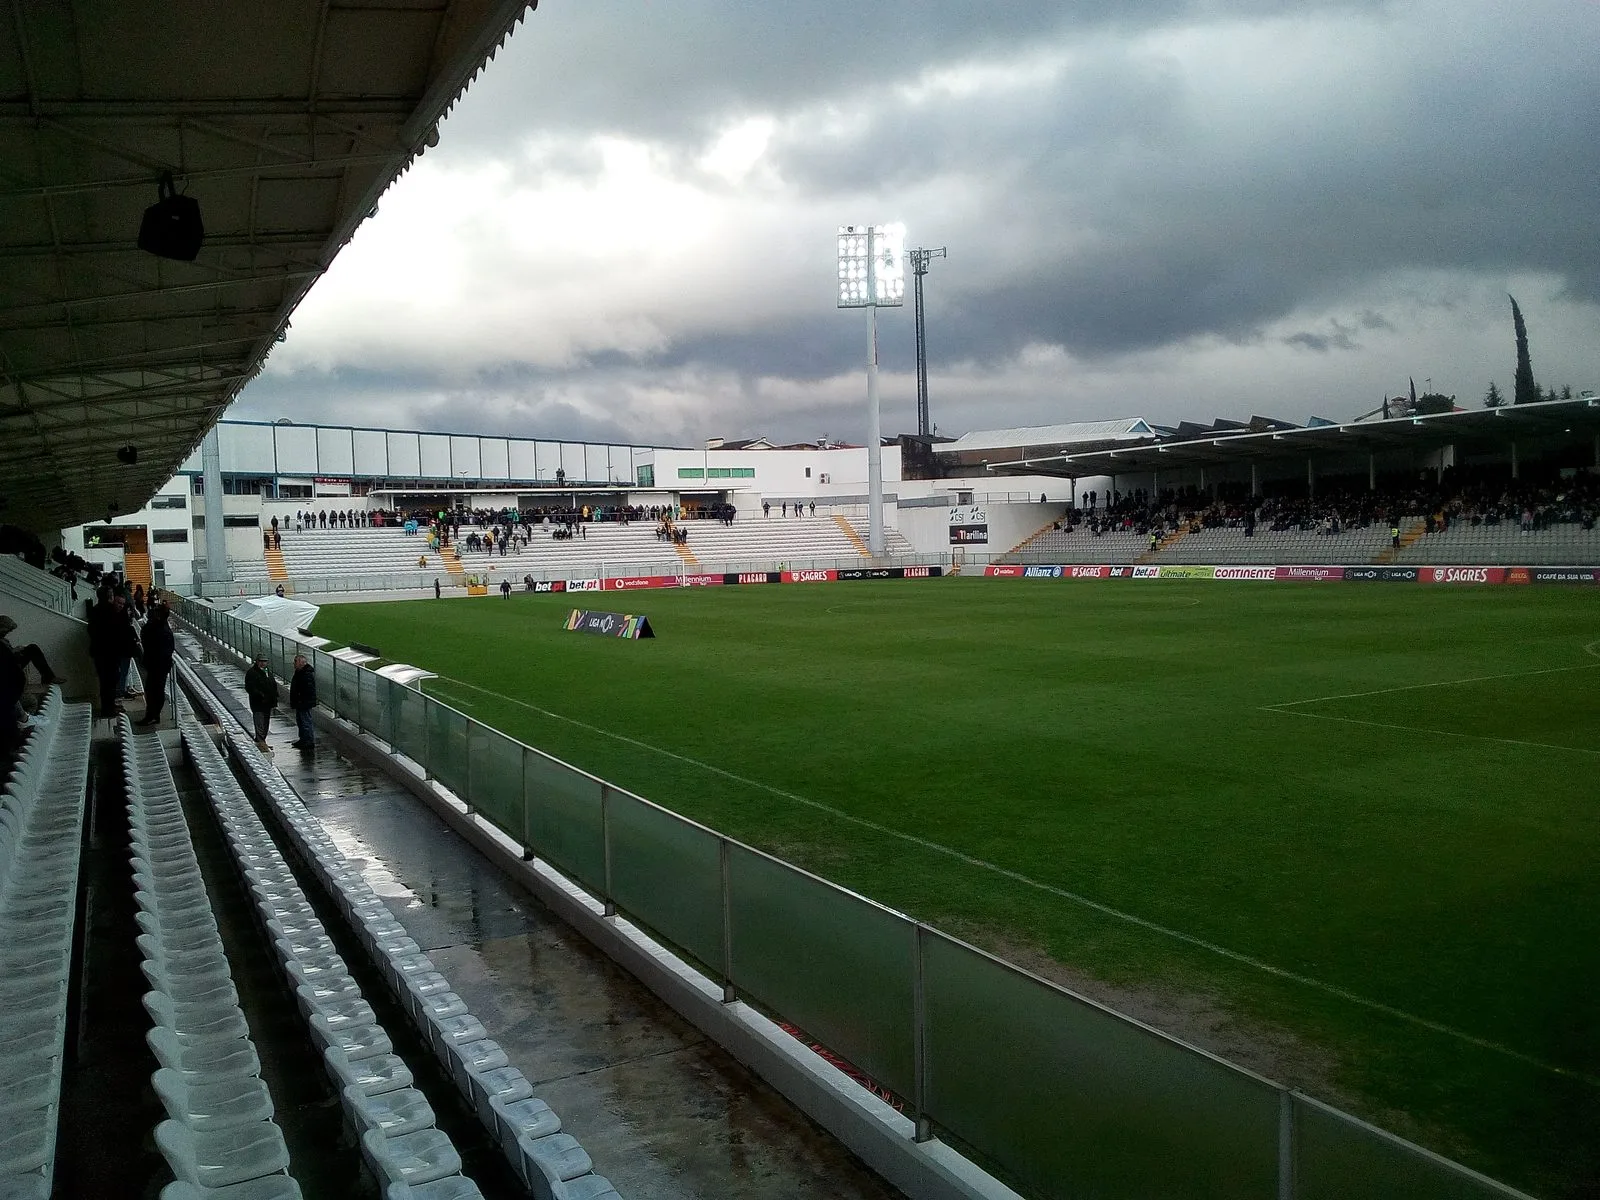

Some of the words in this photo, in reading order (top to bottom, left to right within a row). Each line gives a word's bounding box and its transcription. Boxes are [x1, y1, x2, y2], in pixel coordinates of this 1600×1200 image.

[800, 571, 828, 581] SAGRES
[1024, 566, 1052, 577] Allianz
[1078, 566, 1102, 577] SAGRES
[1288, 567, 1329, 577] Millennium
[1445, 568, 1488, 582] SAGRES
[569, 580, 597, 590] bet.pt
[589, 618, 600, 627] LIGA
